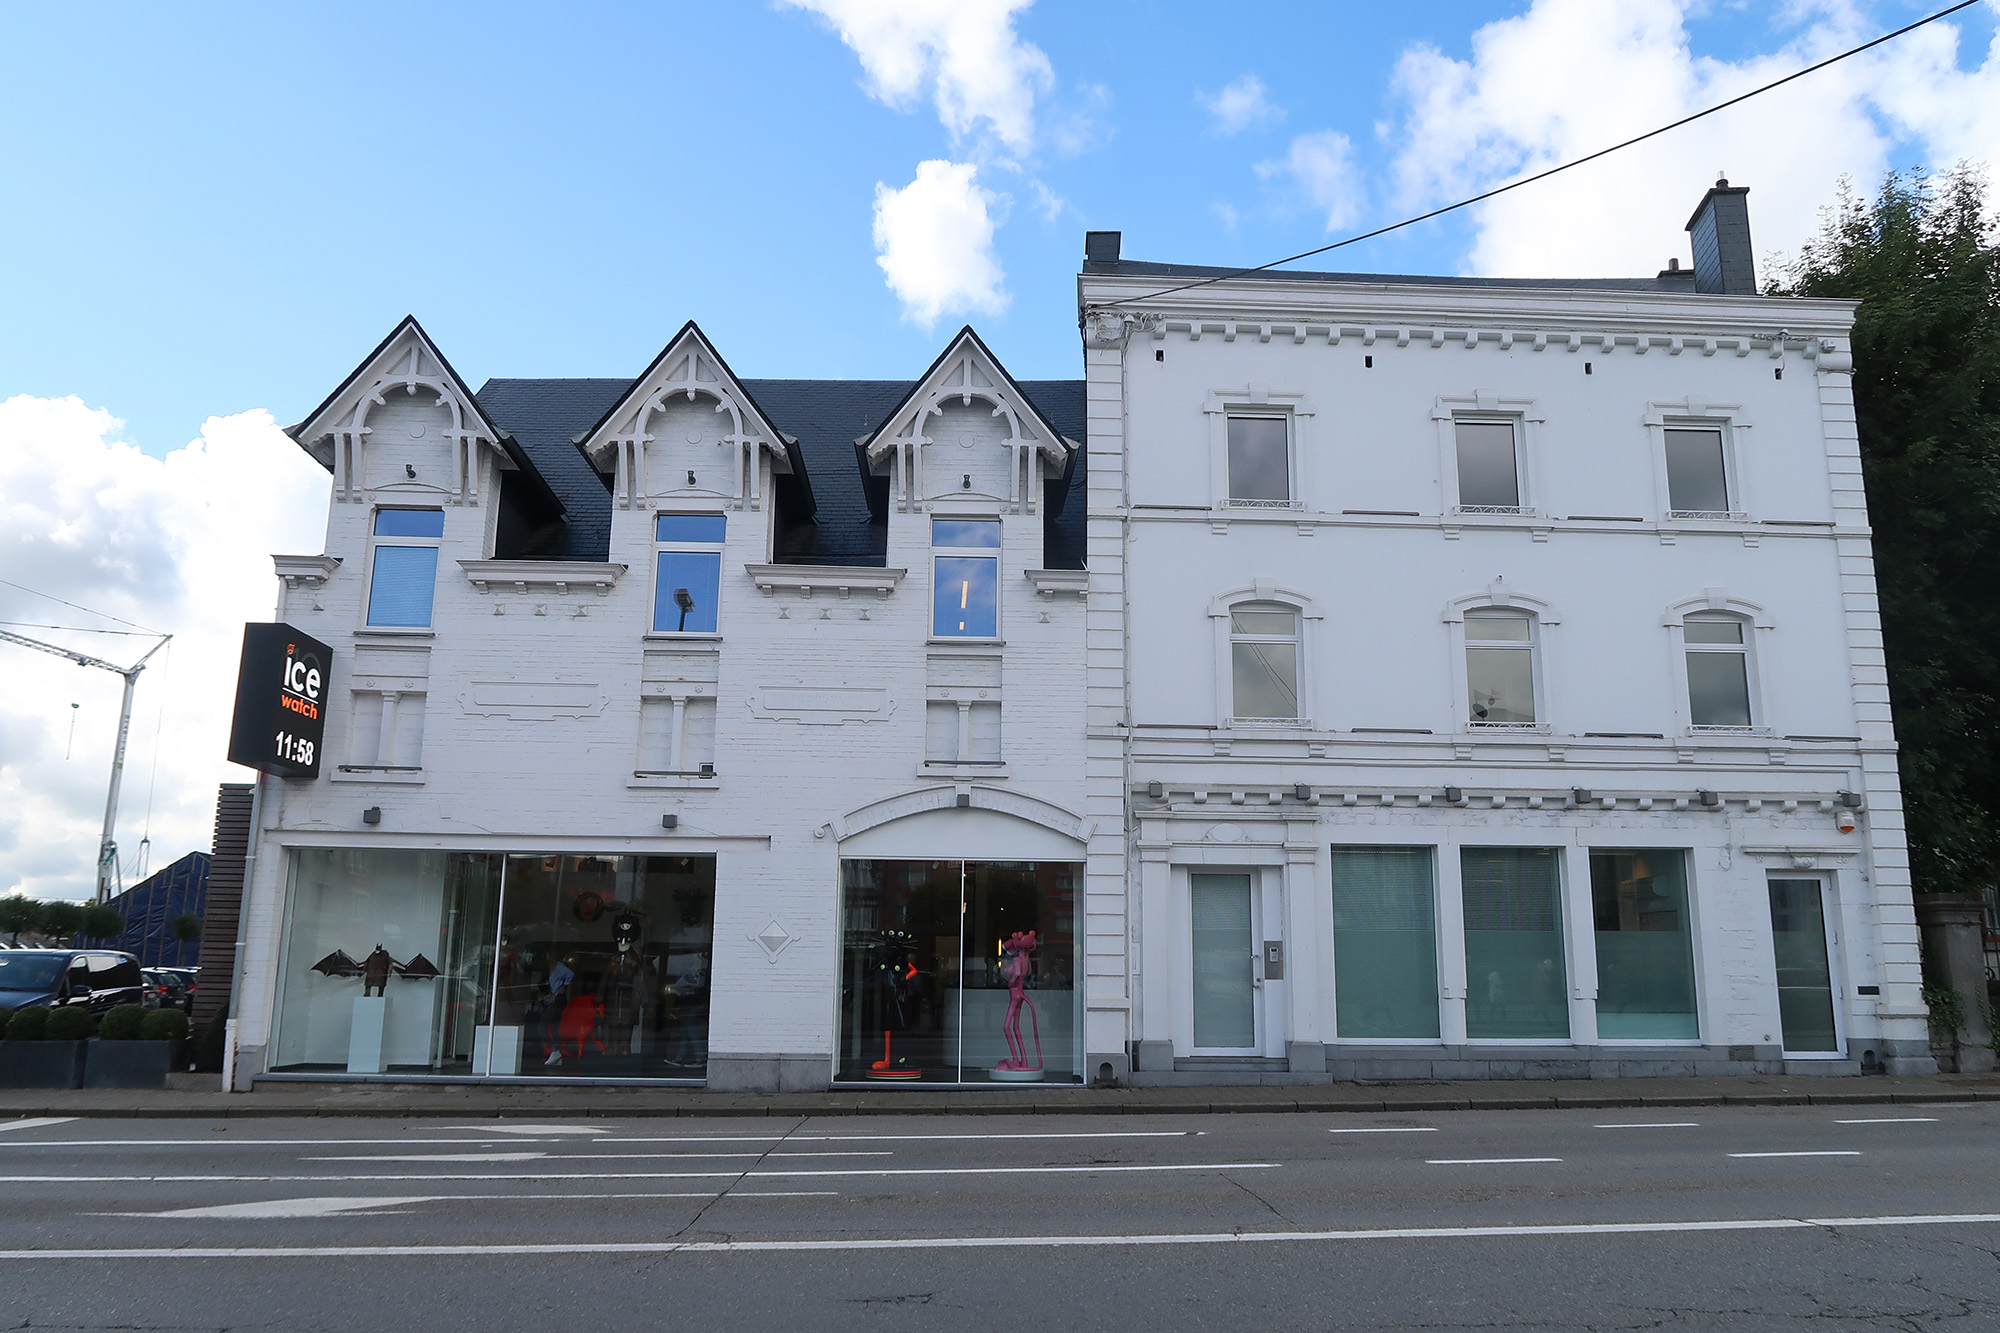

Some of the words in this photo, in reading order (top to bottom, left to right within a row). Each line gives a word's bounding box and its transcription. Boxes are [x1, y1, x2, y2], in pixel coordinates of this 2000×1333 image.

[283, 656, 321, 699] ice
[281, 694, 319, 720] watch
[275, 731, 315, 766] 11:58
